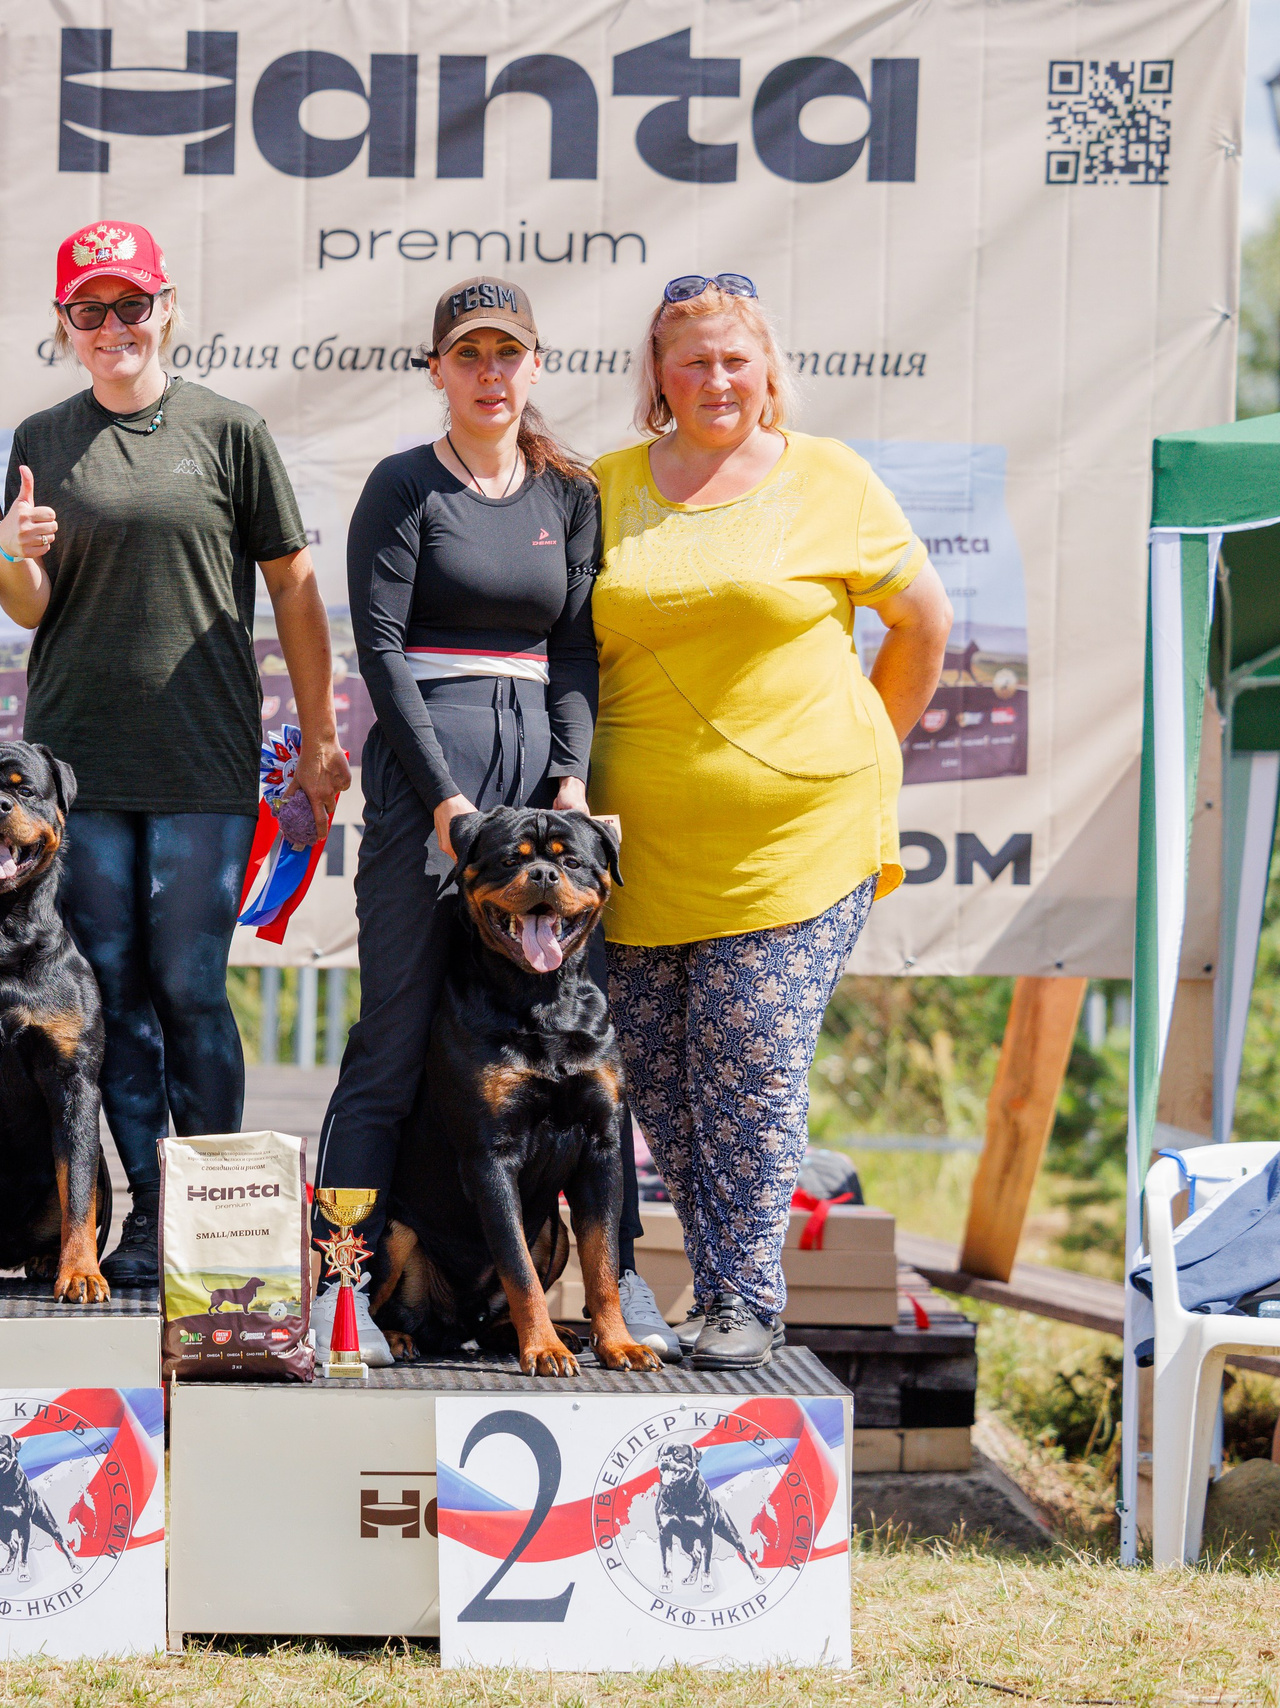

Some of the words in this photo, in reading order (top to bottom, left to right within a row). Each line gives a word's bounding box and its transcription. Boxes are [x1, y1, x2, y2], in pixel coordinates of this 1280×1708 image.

[57, 26, 919, 184] Hanta
[320, 220, 647, 270] premium
[450, 283, 517, 318] FCSM
[187, 1182, 280, 1202] Hanta
[214, 1202, 251, 1210] premium
[196, 1228, 270, 1240] SMALL/MEDIUM
[14, 1402, 89, 1437] КЛУБ
[93, 1442, 129, 1561] РОССИИ
[596, 1416, 676, 1570] РОТВЕЙЛЕР
[694, 1412, 769, 1447] КЛУБ
[774, 1453, 811, 1571] РОССИИ
[457, 1409, 576, 1623] 2
[650, 1594, 768, 1627] РКФ-НКПР
